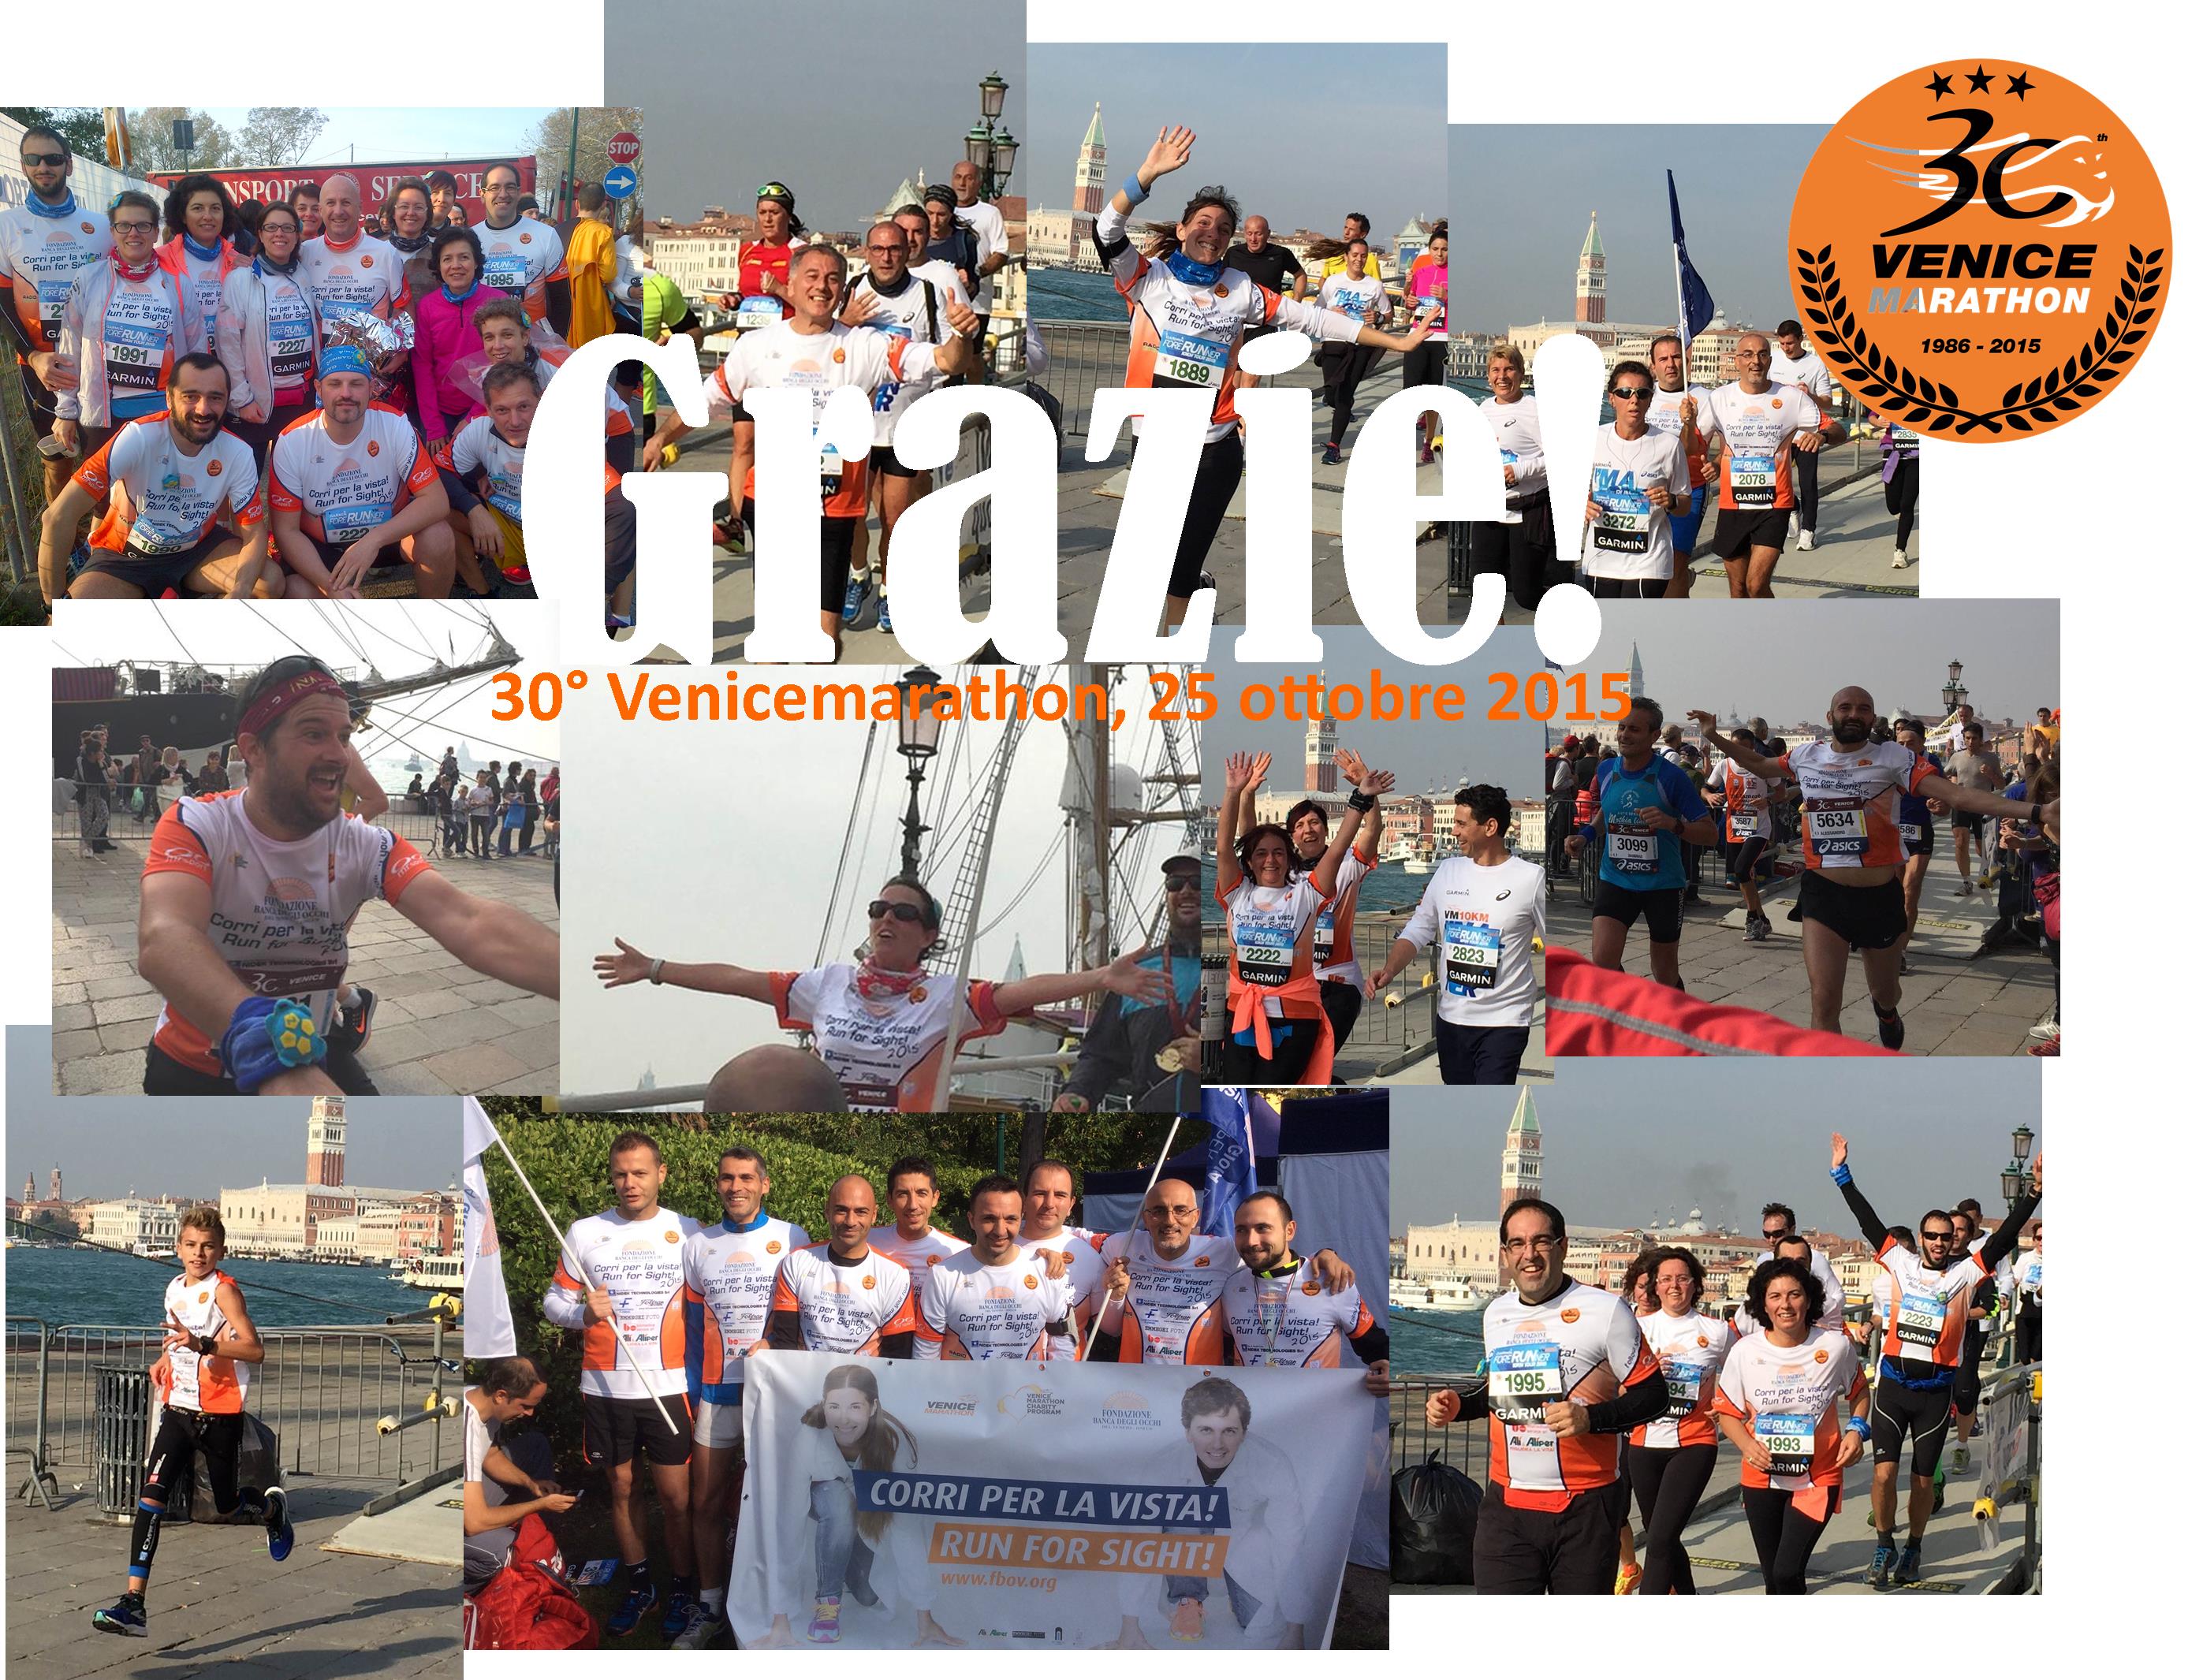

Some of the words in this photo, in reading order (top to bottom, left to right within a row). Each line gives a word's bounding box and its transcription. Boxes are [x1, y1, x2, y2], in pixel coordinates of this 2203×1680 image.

[608, 142, 639, 155] STOP
[32, 264, 53, 273] Run
[484, 273, 515, 286] 1995
[1163, 300, 1189, 315] Corri
[1168, 313, 1189, 326] Run
[1190, 320, 1206, 331] for
[1207, 324, 1235, 336] Sight!
[278, 339, 306, 355] 2227
[112, 345, 148, 365] 1991
[274, 359, 311, 373] GARMIN
[1169, 359, 1210, 384] 1889
[309, 490, 334, 498] Corri
[334, 486, 351, 497] per
[364, 475, 390, 490] vista!
[1738, 473, 1767, 486] 2078
[337, 495, 354, 505] for
[1735, 493, 1773, 501] GARMIN
[180, 511, 210, 520] Sight!
[1602, 512, 1637, 530] 3272
[339, 527, 375, 542] 222
[141, 539, 182, 554] 1990
[1597, 536, 1645, 550] GARMIN
[1835, 781, 1862, 792] Sight!
[1735, 817, 1752, 825] 3587
[1816, 811, 1855, 828] 5634
[1616, 837, 1649, 853] 3099
[1831, 840, 1861, 851] asics
[1626, 862, 1653, 872] asics
[1445, 888, 1471, 897] GARMIN
[210, 912, 260, 933] Corri
[262, 924, 294, 938] per
[222, 933, 261, 949] Run
[1246, 947, 1281, 964] 2222
[1452, 945, 1485, 964] 2823
[289, 973, 326, 985] VENICE
[1241, 970, 1287, 984] GARMIN
[1449, 970, 1491, 985] GARMIN
[594, 1263, 620, 1273] Corri
[622, 1265, 642, 1273] per
[644, 1262, 654, 1271] la
[658, 1262, 683, 1271] vista!
[602, 1272, 623, 1281] Run
[626, 1272, 643, 1280] for
[645, 1271, 675, 1282] Sight!
[659, 1276, 683, 1288] 2015
[703, 1276, 723, 1287] Corri
[725, 1276, 742, 1287] per
[744, 1275, 755, 1284] la
[1129, 1272, 1152, 1282] Corri
[1152, 1276, 1171, 1285] per
[710, 1287, 726, 1295] Run
[729, 1285, 743, 1294] for
[744, 1283, 773, 1294] Sight!
[1135, 1281, 1153, 1291] Run
[1155, 1283, 1171, 1292] for
[1172, 1285, 1203, 1296] Sight!
[1186, 1291, 1213, 1304] 2015
[799, 1301, 818, 1312] Corri
[818, 1306, 836, 1315] per
[837, 1307, 846, 1316] la
[848, 1309, 874, 1320] vista!
[959, 1313, 984, 1323] Corri
[986, 1313, 1002, 1324] per
[1004, 1312, 1014, 1321] la
[1016, 1311, 1041, 1321] vista!
[804, 1312, 818, 1321] Run
[820, 1313, 836, 1324] for
[837, 1316, 864, 1328] Sight!
[967, 1323, 986, 1332] Run
[989, 1322, 1003, 1331] for
[1005, 1321, 1034, 1332] Sight!
[1230, 1317, 1251, 1326] Corri
[1288, 1317, 1320, 1327] vista!
[1904, 1312, 1933, 1328] 2223
[848, 1324, 872, 1336] 2015
[1236, 1326, 1254, 1335] Run
[1257, 1326, 1272, 1335] for
[1291, 1332, 1320, 1347] 2015
[1897, 1330, 1936, 1345] GARMIN
[1504, 1372, 1546, 1393] 1995
[1754, 1388, 1776, 1398] Corri
[1778, 1388, 1794, 1398] per
[1761, 1397, 1780, 1406] Run
[1782, 1395, 1795, 1404] for
[1798, 1392, 1824, 1405] Sight!
[924, 1407, 975, 1417] MARATHON
[927, 1400, 977, 1411] VENICE
[1102, 1409, 1152, 1419] FONDAZIONE
[1494, 1406, 1546, 1421] GARMI
[1116, 1417, 1137, 1426] DEGLI
[1139, 1418, 1161, 1427] OCCHI
[1765, 1436, 1801, 1453] 1993
[870, 1477, 971, 1511] CORRI
[978, 1484, 1046, 1515] PER
[1053, 1489, 1097, 1518] LA
[1109, 1490, 1220, 1522] VISTA!
[939, 1529, 1018, 1561] RUN
[1021, 1533, 1091, 1565] FOR
[1098, 1537, 1215, 1570] SIGHT!
[940, 1569, 1057, 1592] www.fbov.org
